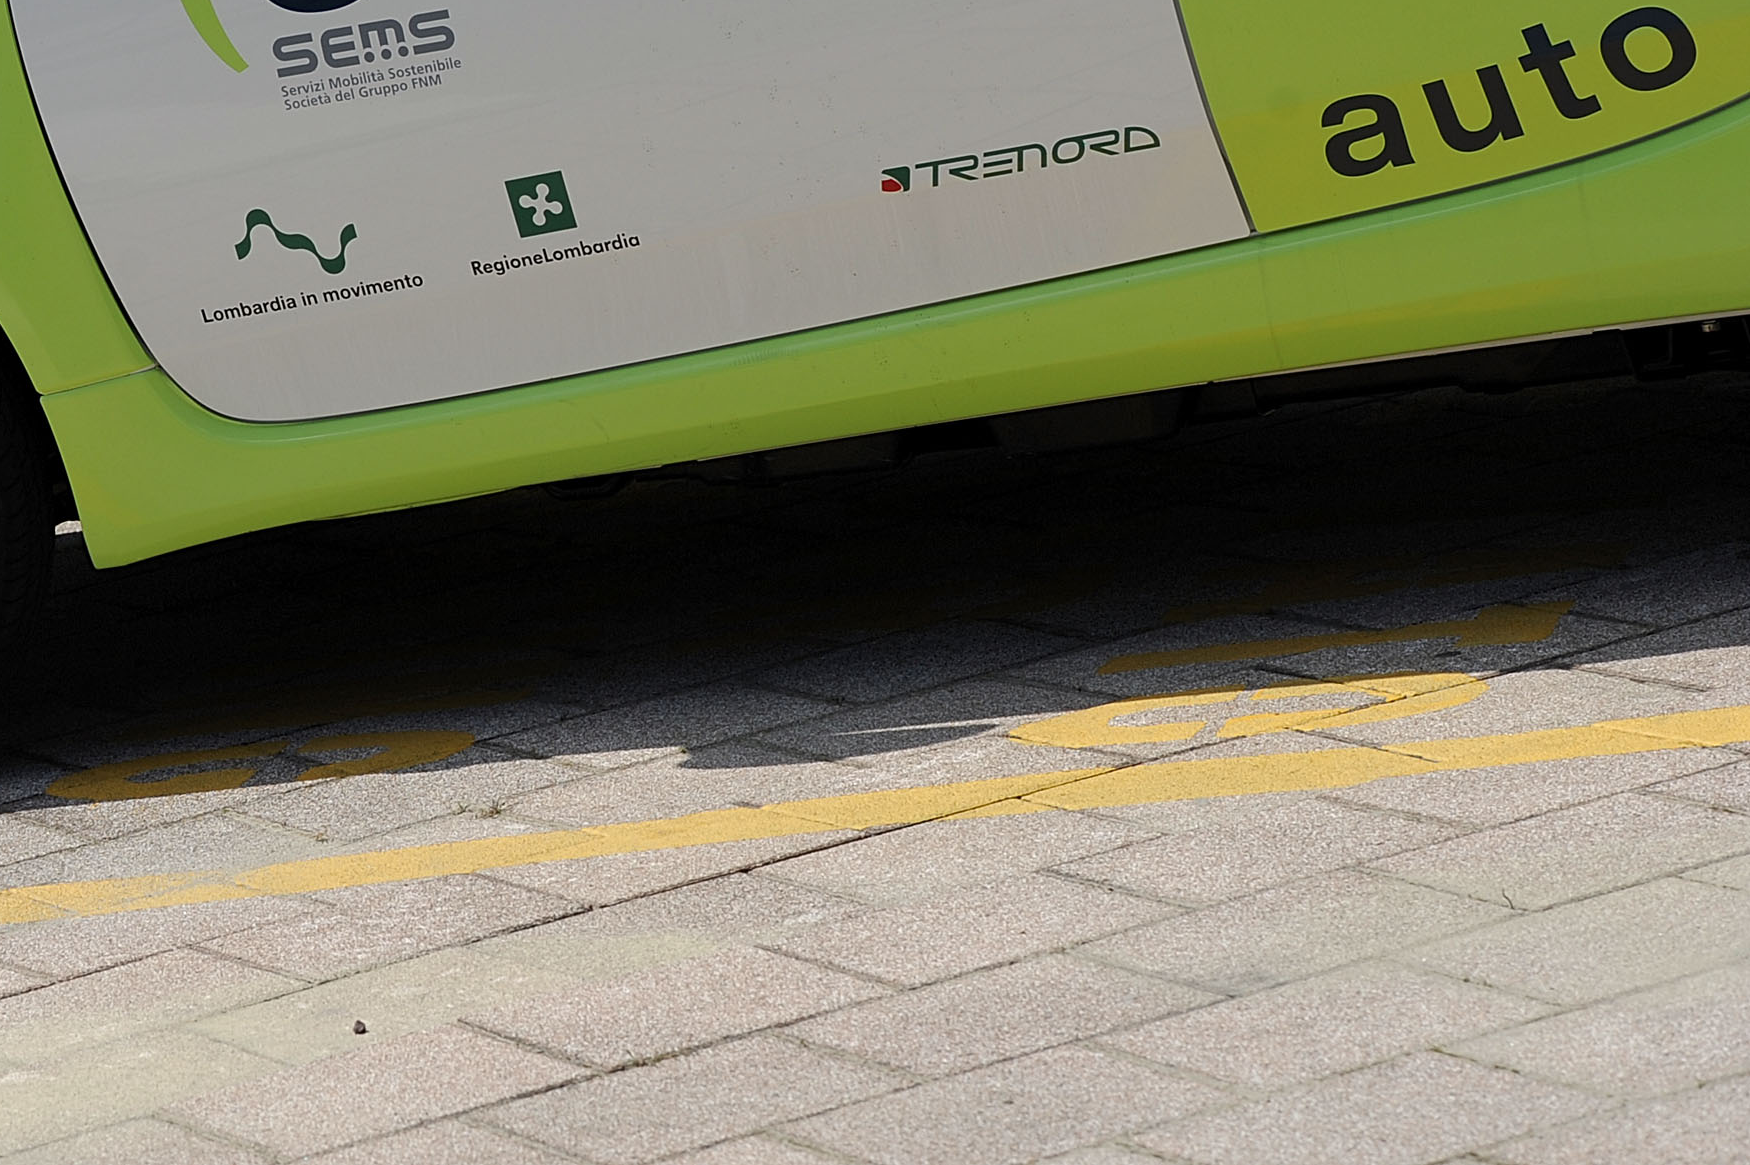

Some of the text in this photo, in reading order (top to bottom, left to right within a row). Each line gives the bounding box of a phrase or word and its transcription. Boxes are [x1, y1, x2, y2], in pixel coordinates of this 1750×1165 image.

[281, 57, 462, 97] Servizi Mobilità Sostenibile
[284, 74, 442, 111] Società del Gruppo FNM
[1321, 6, 1697, 177] auto
[915, 126, 1161, 187] TRENORD
[200, 272, 424, 324] Lombardia in movimento
